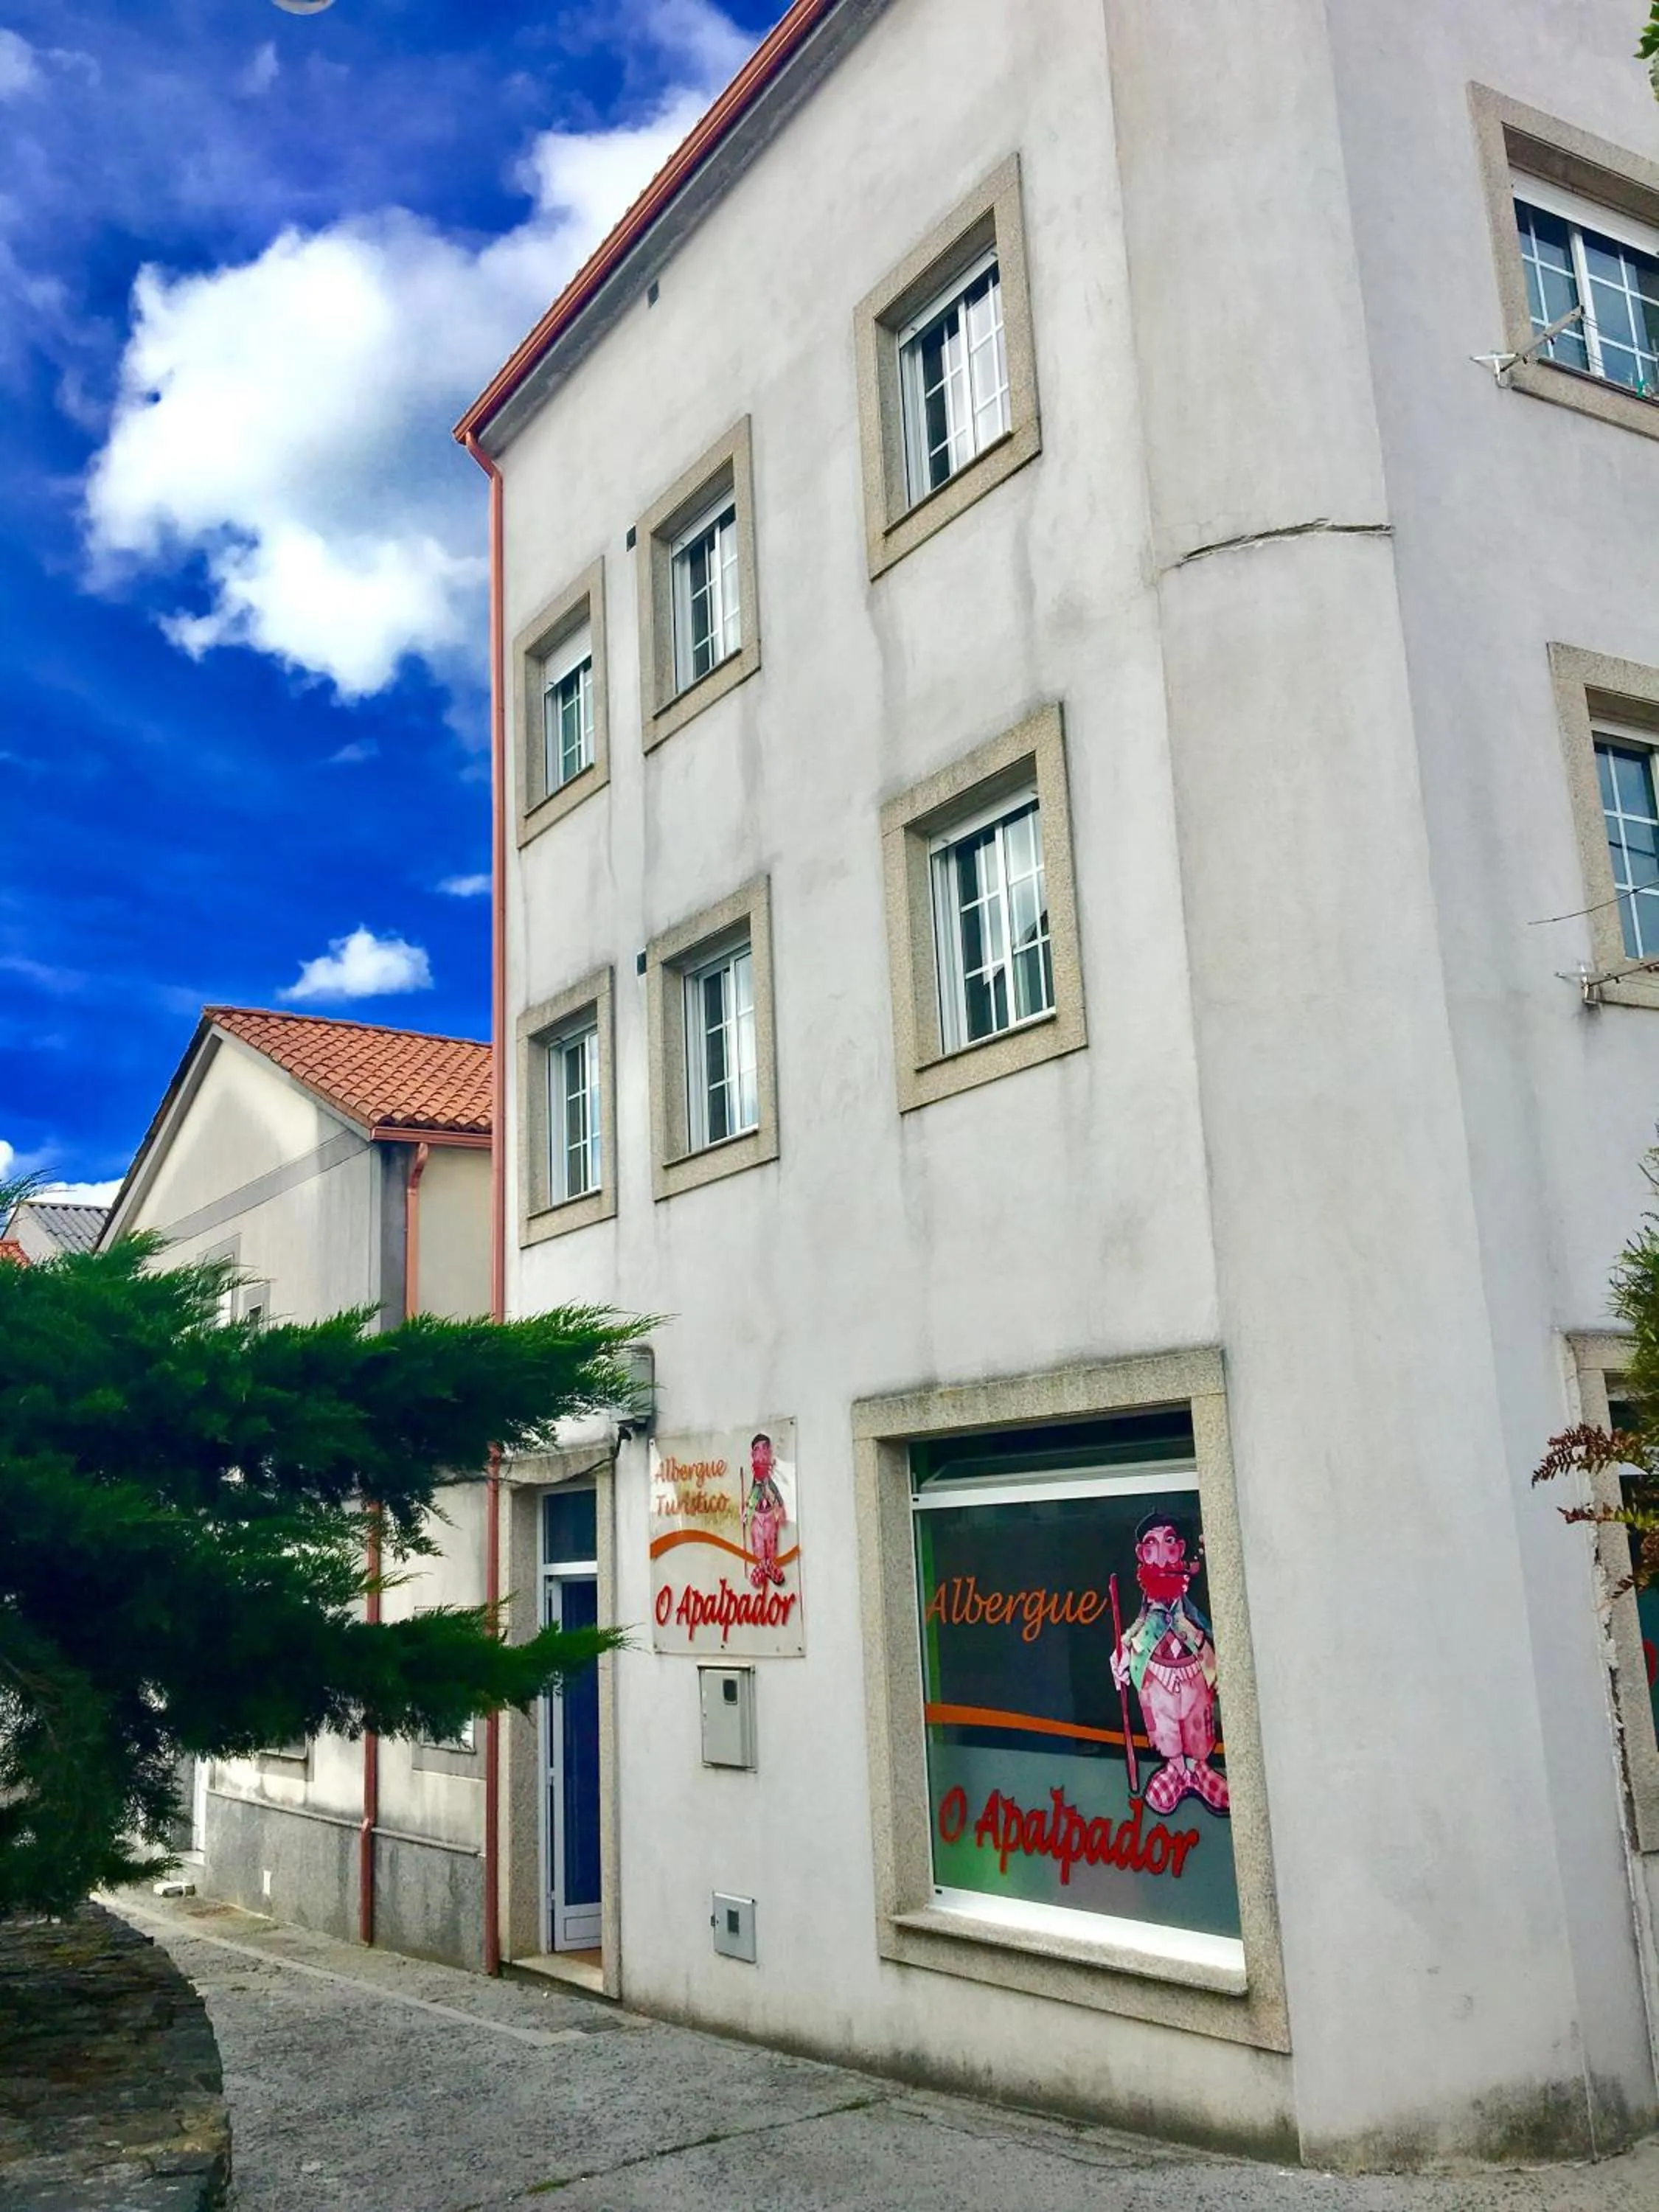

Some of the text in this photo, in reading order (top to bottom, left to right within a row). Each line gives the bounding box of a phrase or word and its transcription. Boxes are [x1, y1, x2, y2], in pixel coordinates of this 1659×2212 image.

[655, 1456, 727, 1488] Albergue
[655, 1577, 796, 1643] O Apalpador
[925, 1576, 1107, 1643] Albergue
[939, 1784, 1200, 1885] O Apalpador
